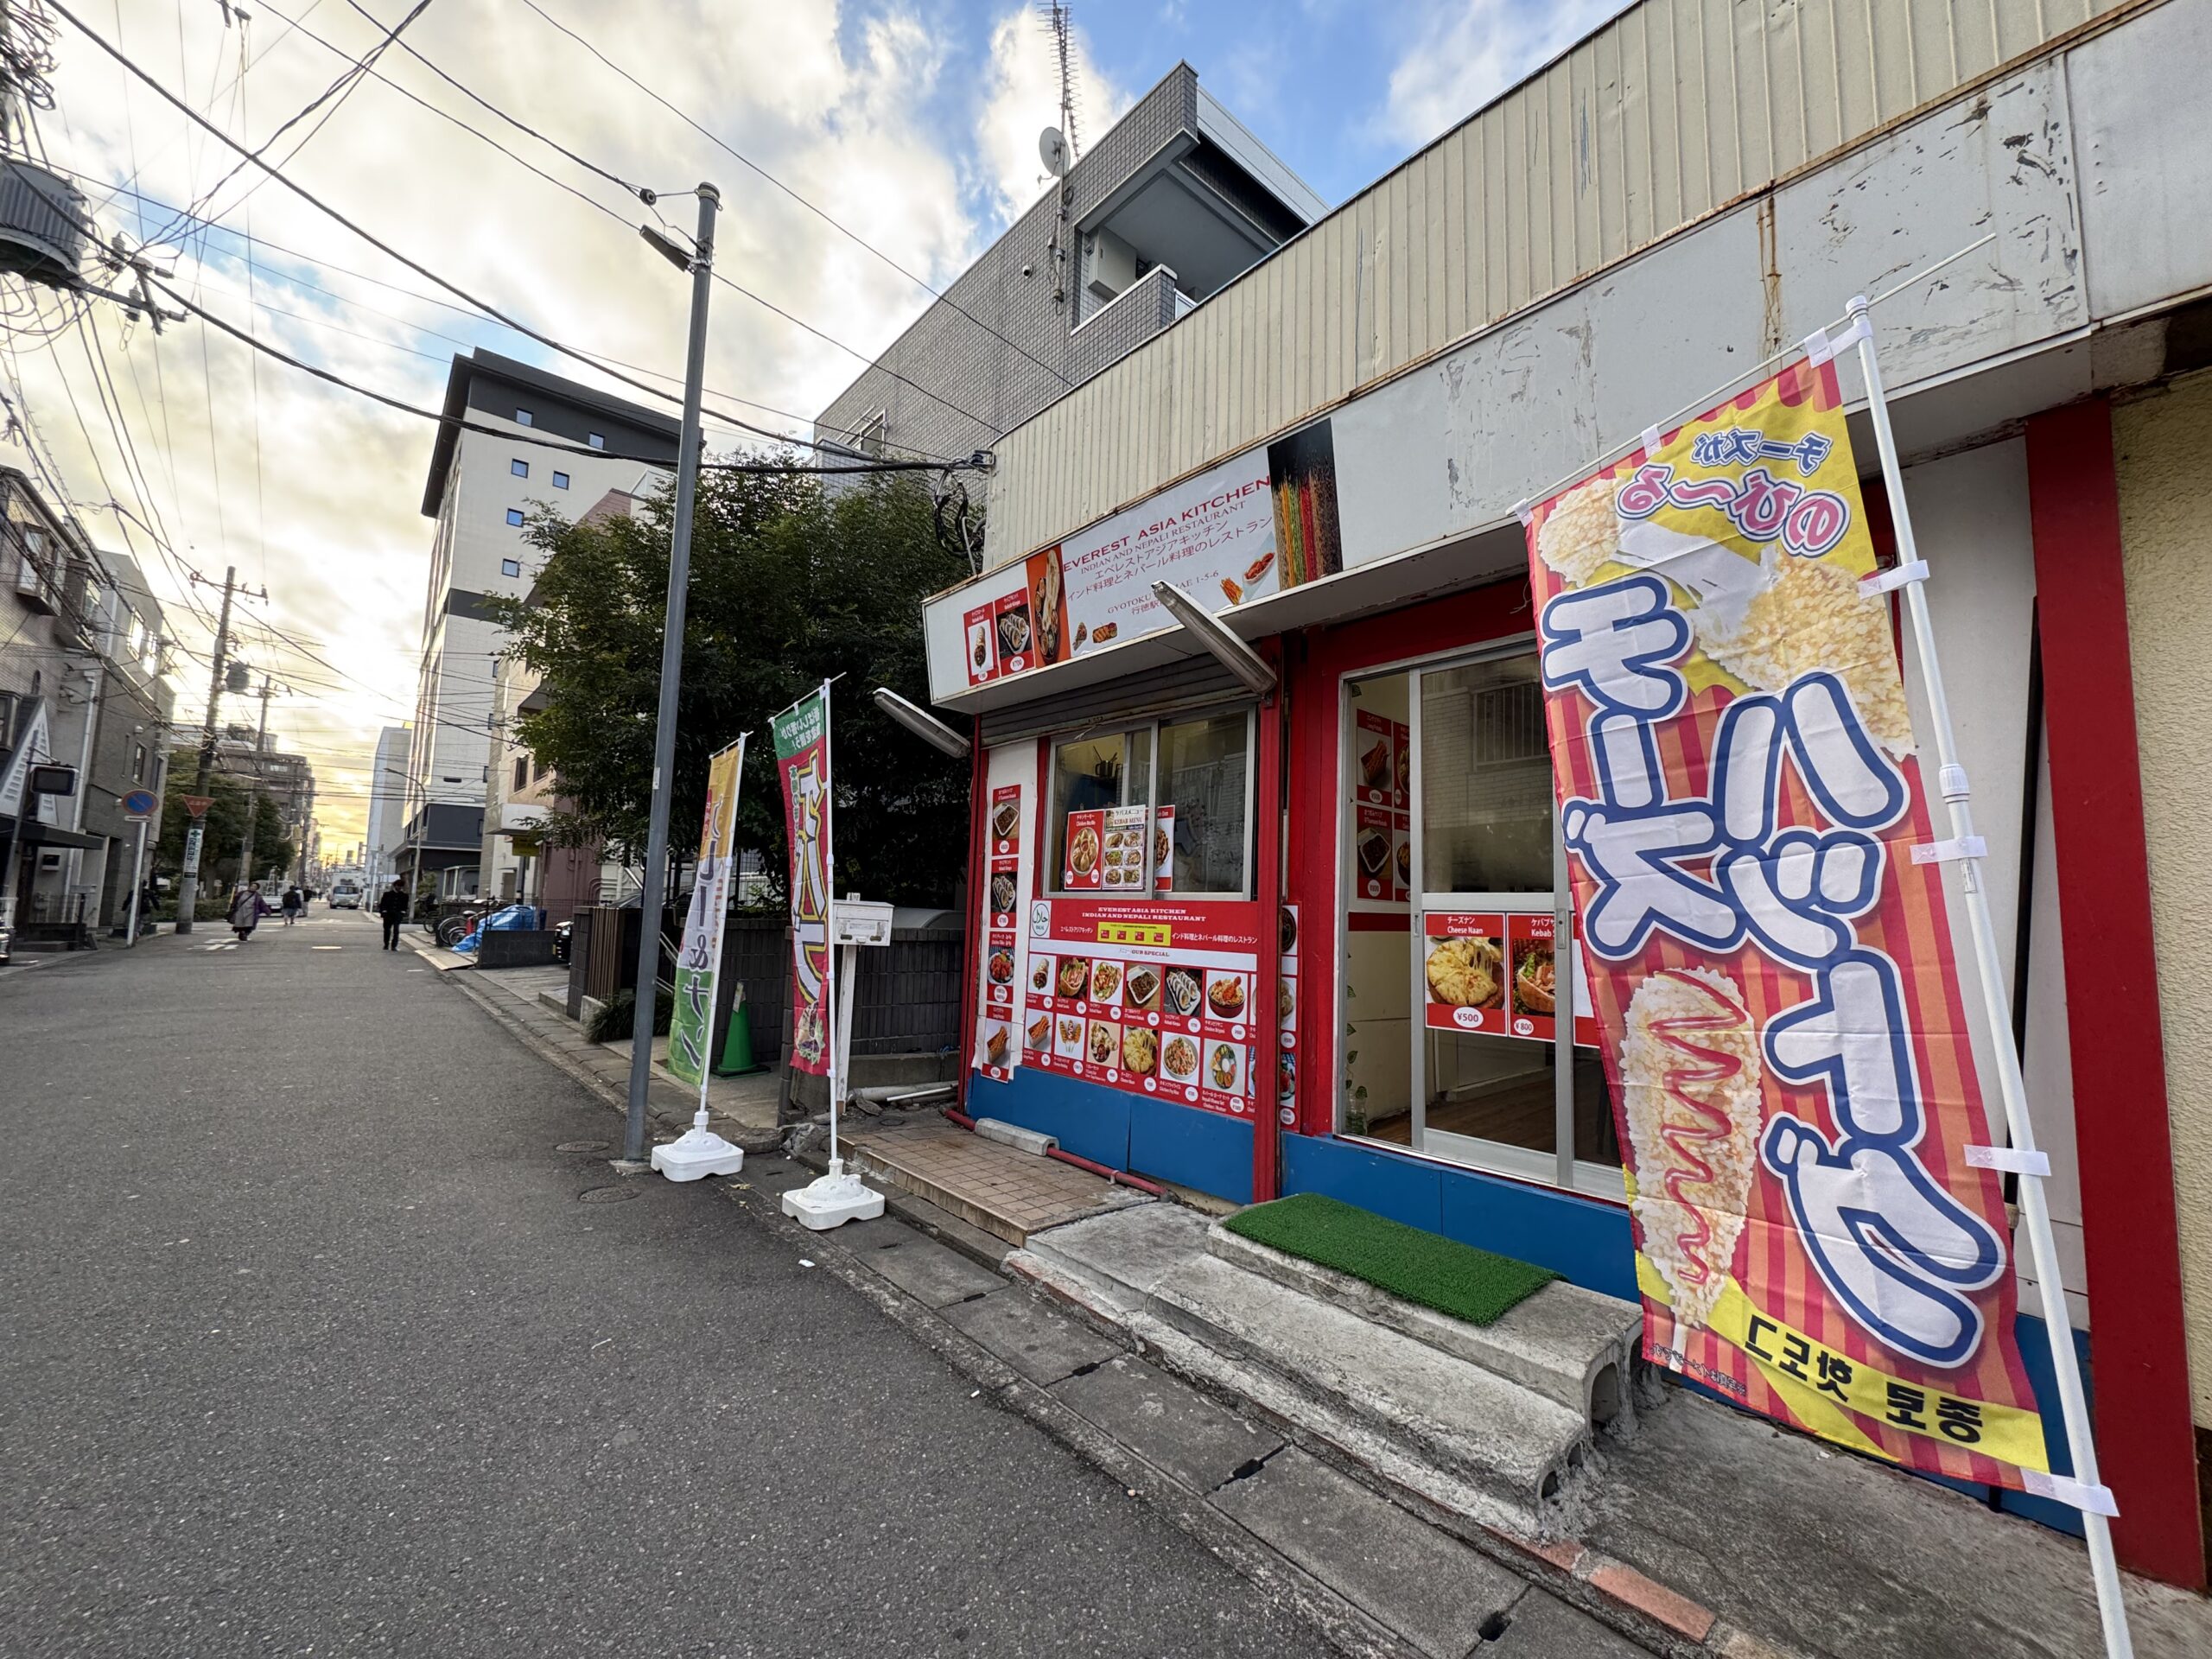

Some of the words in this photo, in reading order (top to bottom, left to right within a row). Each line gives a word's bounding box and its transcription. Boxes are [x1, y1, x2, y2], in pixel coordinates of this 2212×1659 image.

[1063, 536, 1131, 574] EVEREST
[1138, 517, 1177, 541] ASIA
[1182, 475, 1271, 522] KITCHEN
[1081, 559, 1112, 575] INDIAN
[1113, 549, 1133, 563] AND
[1135, 533, 1169, 551] NEPALI
[1171, 500, 1247, 537] RESTAURANT
[1095, 519, 1229, 580] エベレストアジアキッチン
[1067, 517, 1273, 601] インド料理とネパール料理のレストラン
[1108, 594, 1152, 614] GYOTOKU
[1197, 571, 1219, 583] 1-5-6
[1131, 601, 1162, 615] 行徳駅
[1447, 916, 1475, 925] チーズナン
[1457, 1012, 1478, 1022] ¥500
